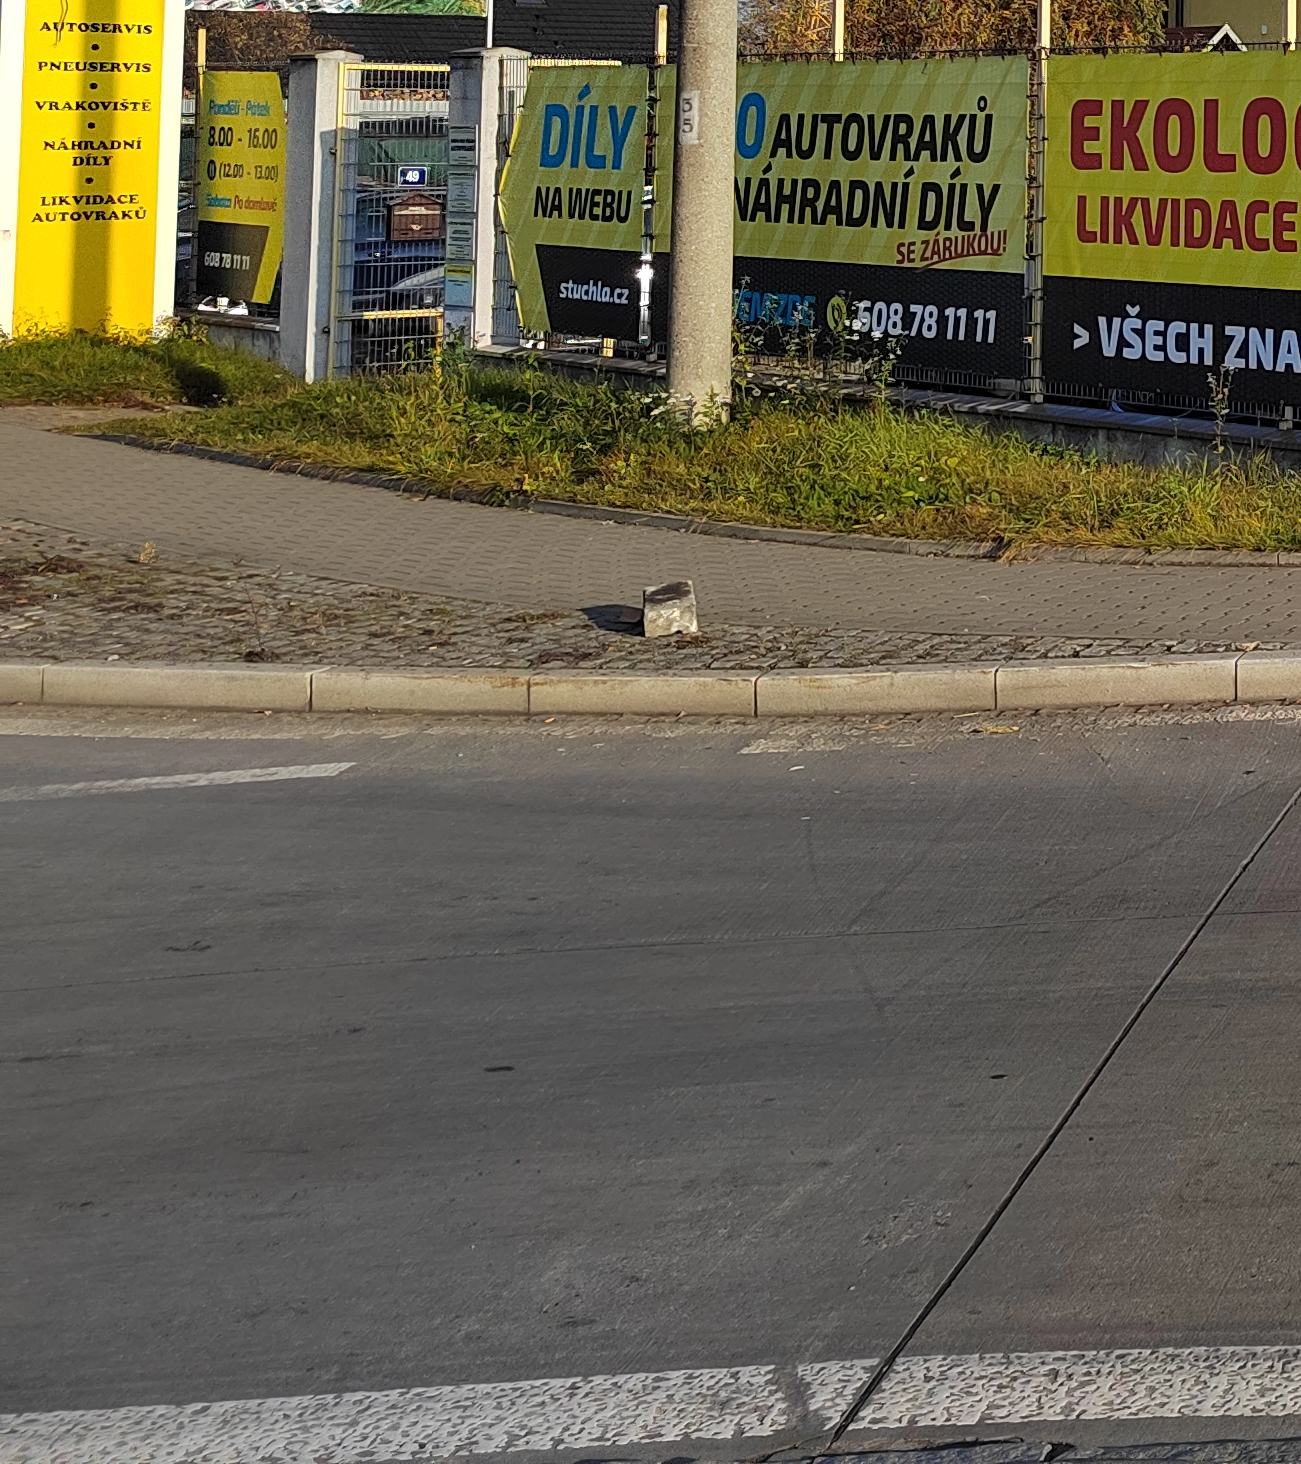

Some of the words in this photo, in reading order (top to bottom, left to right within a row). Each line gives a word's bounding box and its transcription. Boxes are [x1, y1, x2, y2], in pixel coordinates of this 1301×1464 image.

[39, 22, 153, 34] AUTOSERVIS
[37, 61, 151, 73] PNEUSERVIS
[35, 98, 152, 112] VRAKOVIŠTĚ
[208, 126, 233, 147] 8.00
[247, 127, 278, 149] 16.00
[539, 82, 637, 170] DÍLY
[769, 95, 994, 164] AUTOVRAKŮ
[43, 137, 142, 151] NÁHRADNÍ
[72, 153, 113, 167] DÍLY
[405, 170, 420, 182] 49
[40, 194, 139, 207] LIKVIDACE
[534, 186, 563, 219] NA
[567, 187, 632, 223] WEBU
[735, 160, 914, 230] NÁHRADNÍ
[917, 165, 1001, 233] DÍLY
[31, 206, 147, 223] AUTOVRAKŮ
[1076, 194, 1298, 253] LIKVIDACE
[896, 241, 916, 264] SE
[919, 230, 1007, 263] ZÁRUKOU!
[559, 279, 629, 305] stuchla.cz
[909, 304, 938, 339] 78
[944, 306, 967, 341] 11
[973, 308, 997, 343] 11
[1098, 304, 1214, 367] VŠECH
